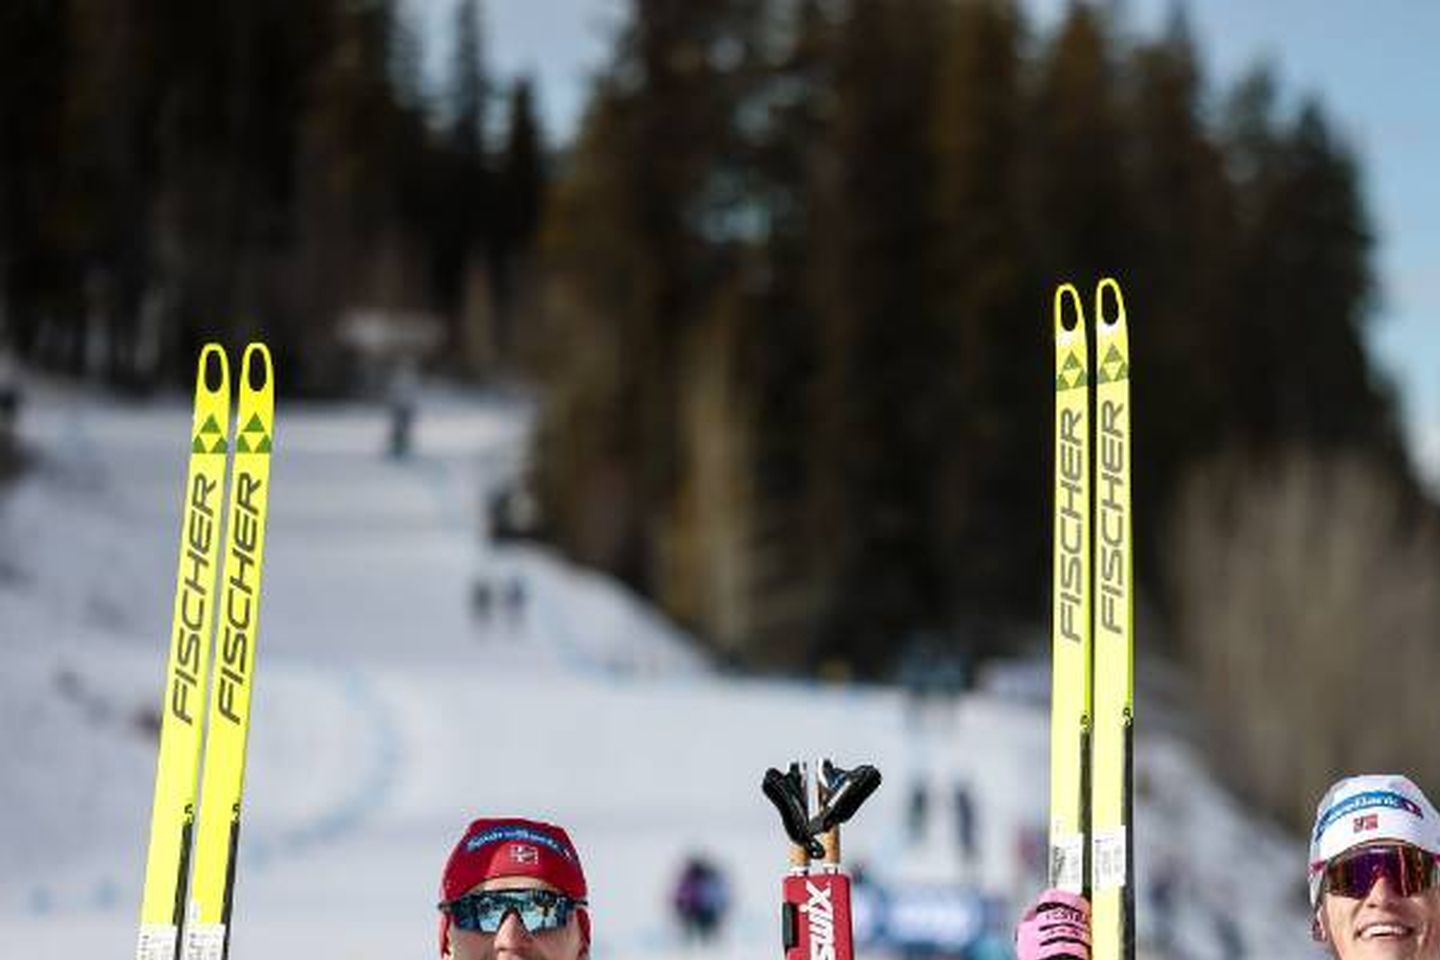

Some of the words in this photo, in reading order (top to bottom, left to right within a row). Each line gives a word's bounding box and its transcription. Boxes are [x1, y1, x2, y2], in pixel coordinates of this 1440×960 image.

[172, 472, 218, 726] FISCHER
[218, 472, 263, 726] FISCHER
[1060, 406, 1082, 643] FISCHER
[1101, 399, 1124, 634] FISCHER
